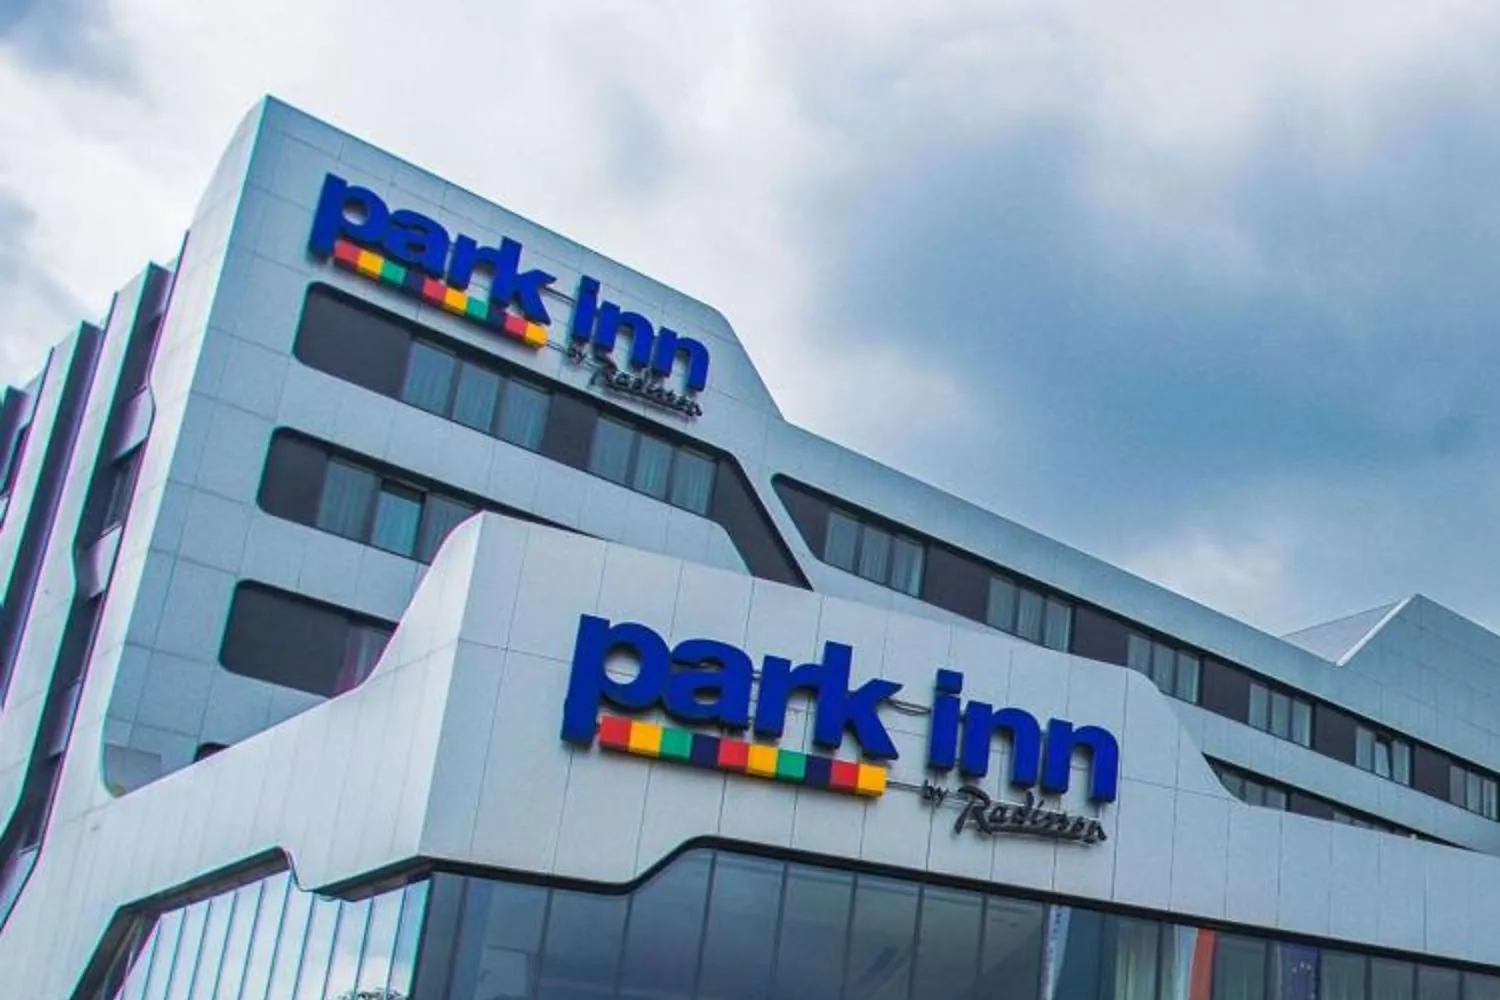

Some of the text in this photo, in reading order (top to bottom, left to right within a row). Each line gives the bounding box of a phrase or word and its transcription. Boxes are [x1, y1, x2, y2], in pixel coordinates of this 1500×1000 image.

[309, 172, 557, 325] park
[561, 614, 1119, 806] park inn
[922, 779, 1108, 845] by Radisson
